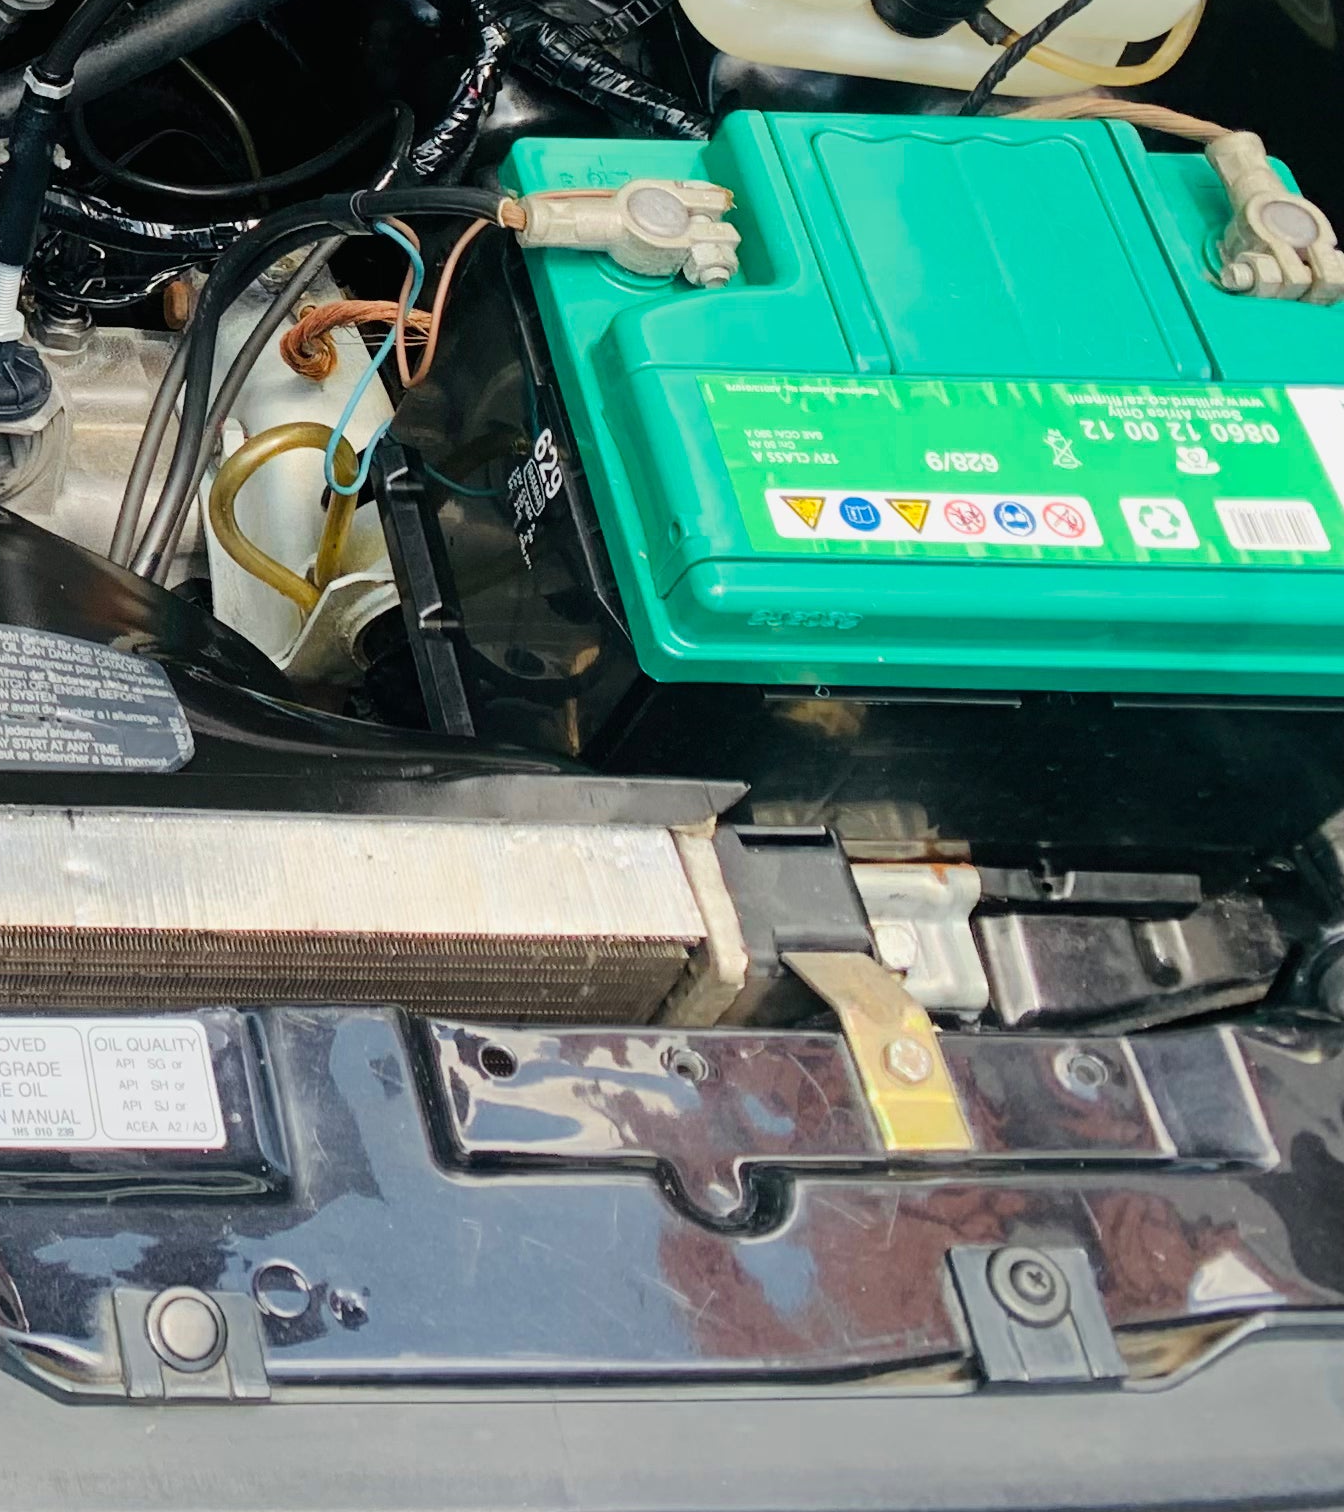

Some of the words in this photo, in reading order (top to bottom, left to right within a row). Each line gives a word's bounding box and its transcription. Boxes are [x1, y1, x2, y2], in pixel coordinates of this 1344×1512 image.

[1108, 405, 1145, 420] Only
[1147, 407, 1192, 421] Africa
[1196, 408, 1243, 422] South
[1079, 419, 1115, 441] 12
[1123, 420, 1160, 441] 00
[1165, 421, 1202, 442] 12
[1210, 423, 1280, 444] 0860
[534, 427, 563, 500] 629
[751, 450, 763, 463] A
[767, 451, 811, 465] CLASS
[814, 451, 840, 465] 12V
[924, 450, 999, 473] 628/9
[2, 640, 21, 654] OIL
[22, 644, 46, 656] CAN
[48, 647, 94, 665] DAMAGE
[75, 665, 99, 677] pour
[28, 680, 52, 691] OFF
[53, 682, 96, 698] ENGINE
[98, 688, 146, 704] BEFORE
[11, 738, 47, 752] START
[50, 741, 66, 752] AT
[67, 742, 91, 753] ANY
[92, 742, 124, 756] TIME.
[17, 750, 30, 761] se
[101, 755, 123, 766] tout
[94, 1037, 122, 1052] OIL
[127, 1038, 197, 1052] QUALITY
[116, 1058, 135, 1069] API
[147, 1058, 166, 1069] SG
[172, 1061, 182, 1069] or
[19, 1082, 48, 1097] OIL
[119, 1080, 138, 1090] API
[150, 1080, 169, 1091] SH
[174, 1082, 185, 1091] or
[122, 1100, 142, 1111] API
[154, 1100, 169, 1111] SJ
[175, 1103, 186, 1111] or
[12, 1109, 81, 1126] MANUAL
[35, 1127, 52, 1137] 010
[126, 1121, 158, 1132] ACEA
